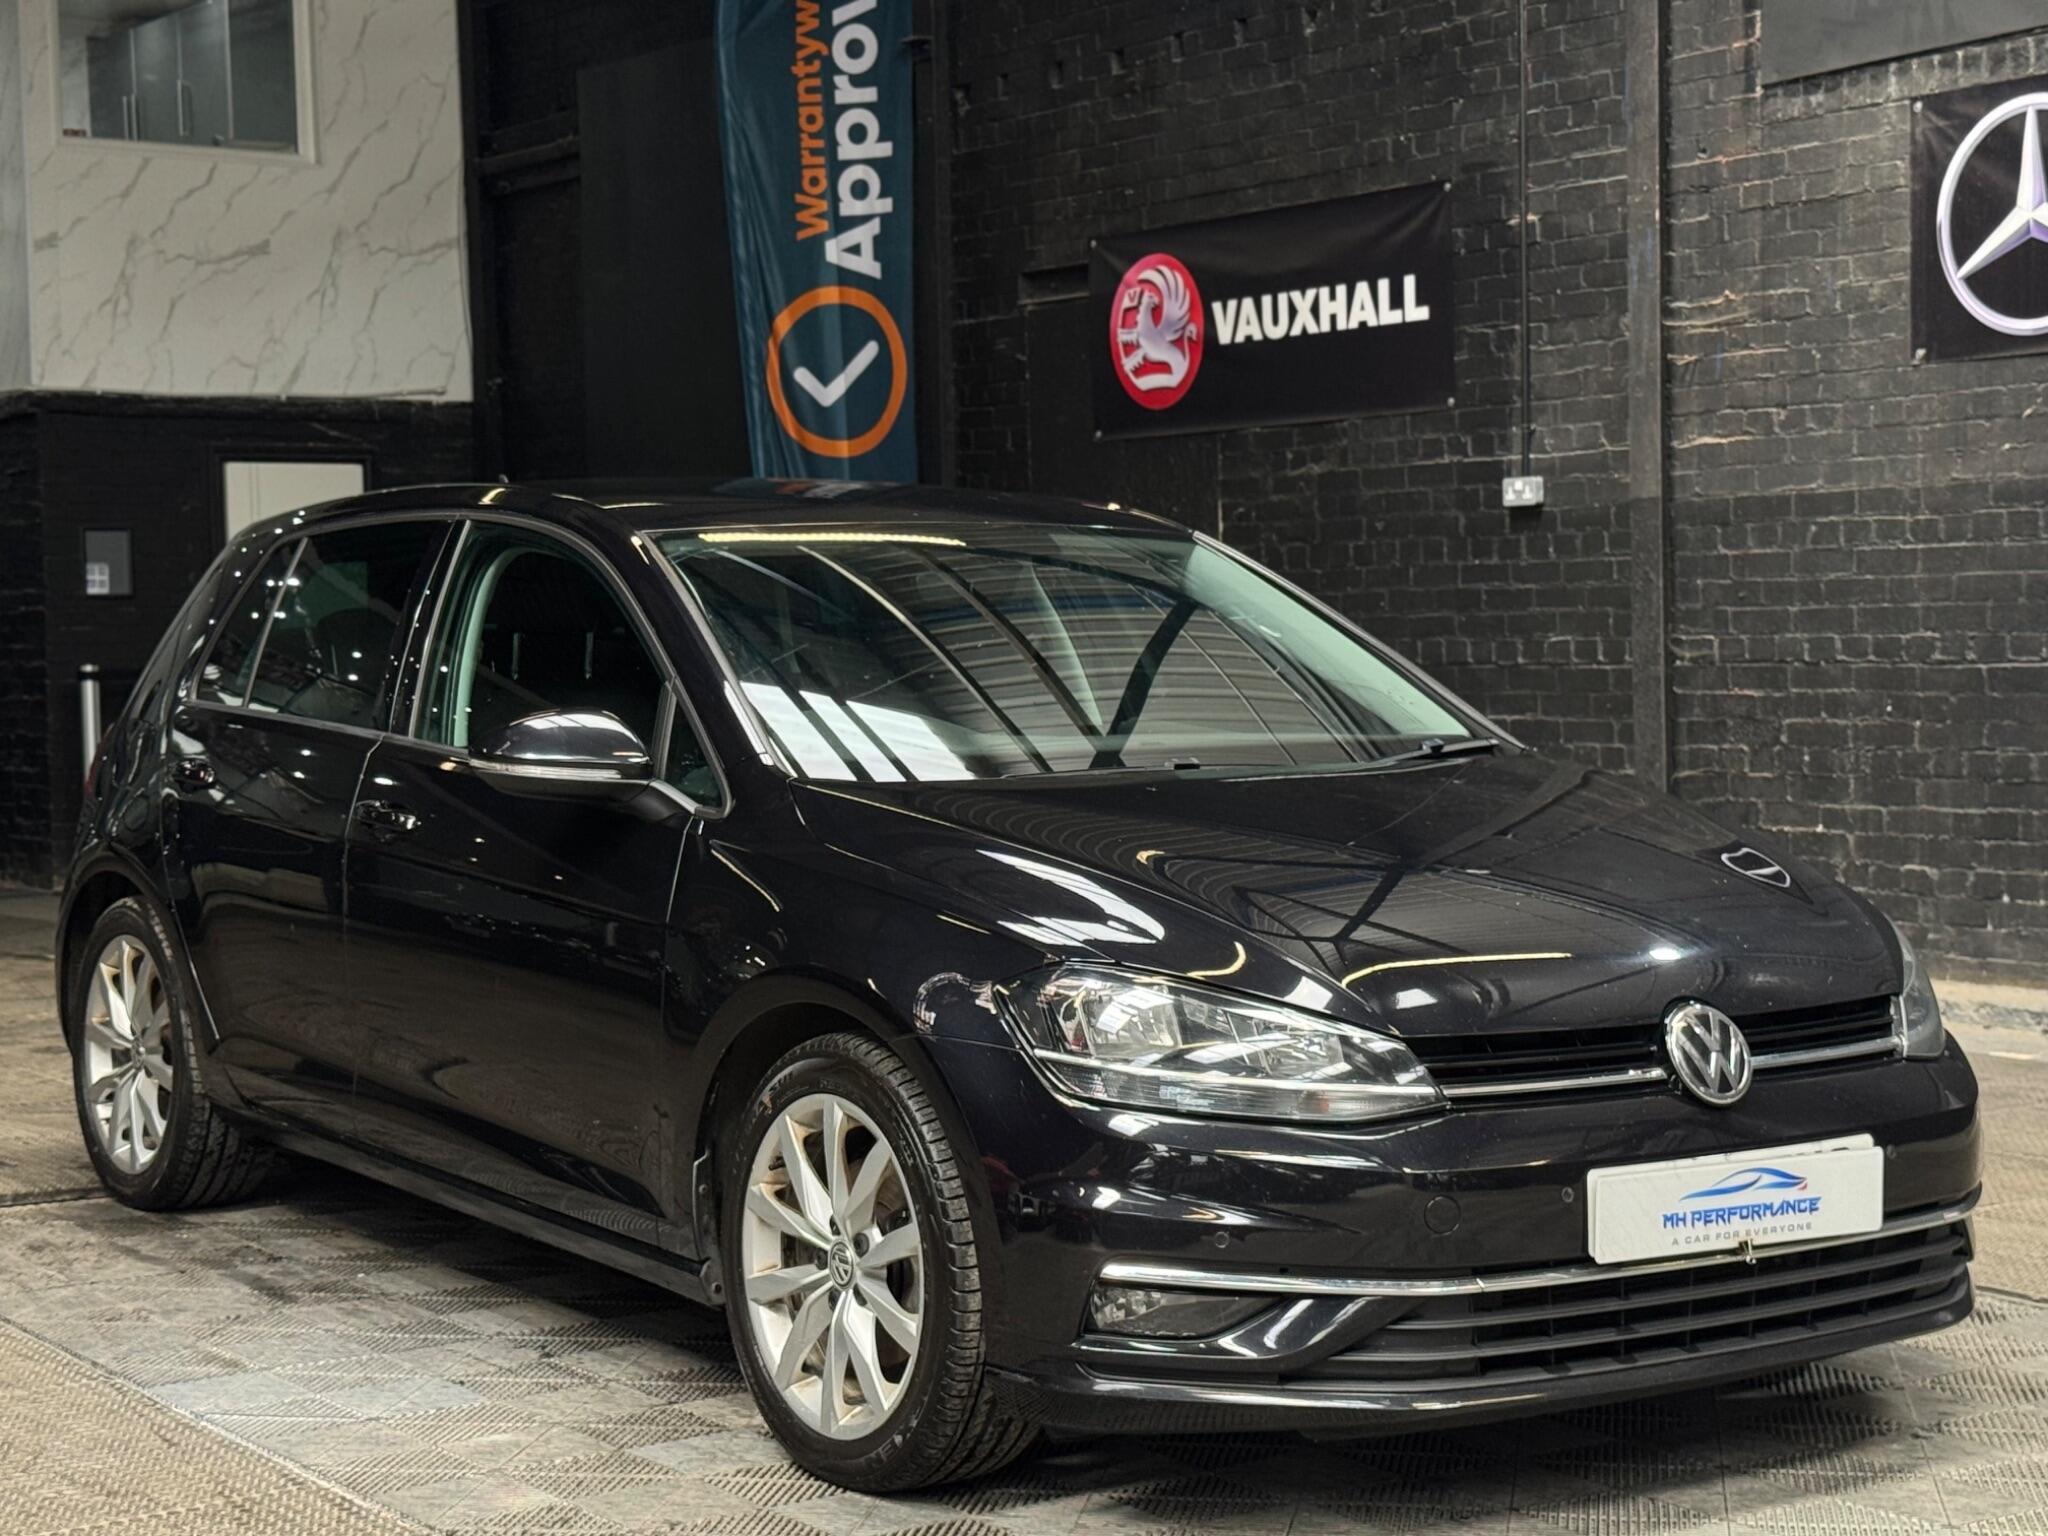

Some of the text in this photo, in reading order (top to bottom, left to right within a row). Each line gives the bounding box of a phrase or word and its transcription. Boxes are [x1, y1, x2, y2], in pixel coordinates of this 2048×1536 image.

[1211, 274, 1430, 345] VAUXHALL
[1662, 1197, 1822, 1230] MH PERFORMANCE
[1671, 1221, 1813, 1246] A CAR FOR EVERYONE
